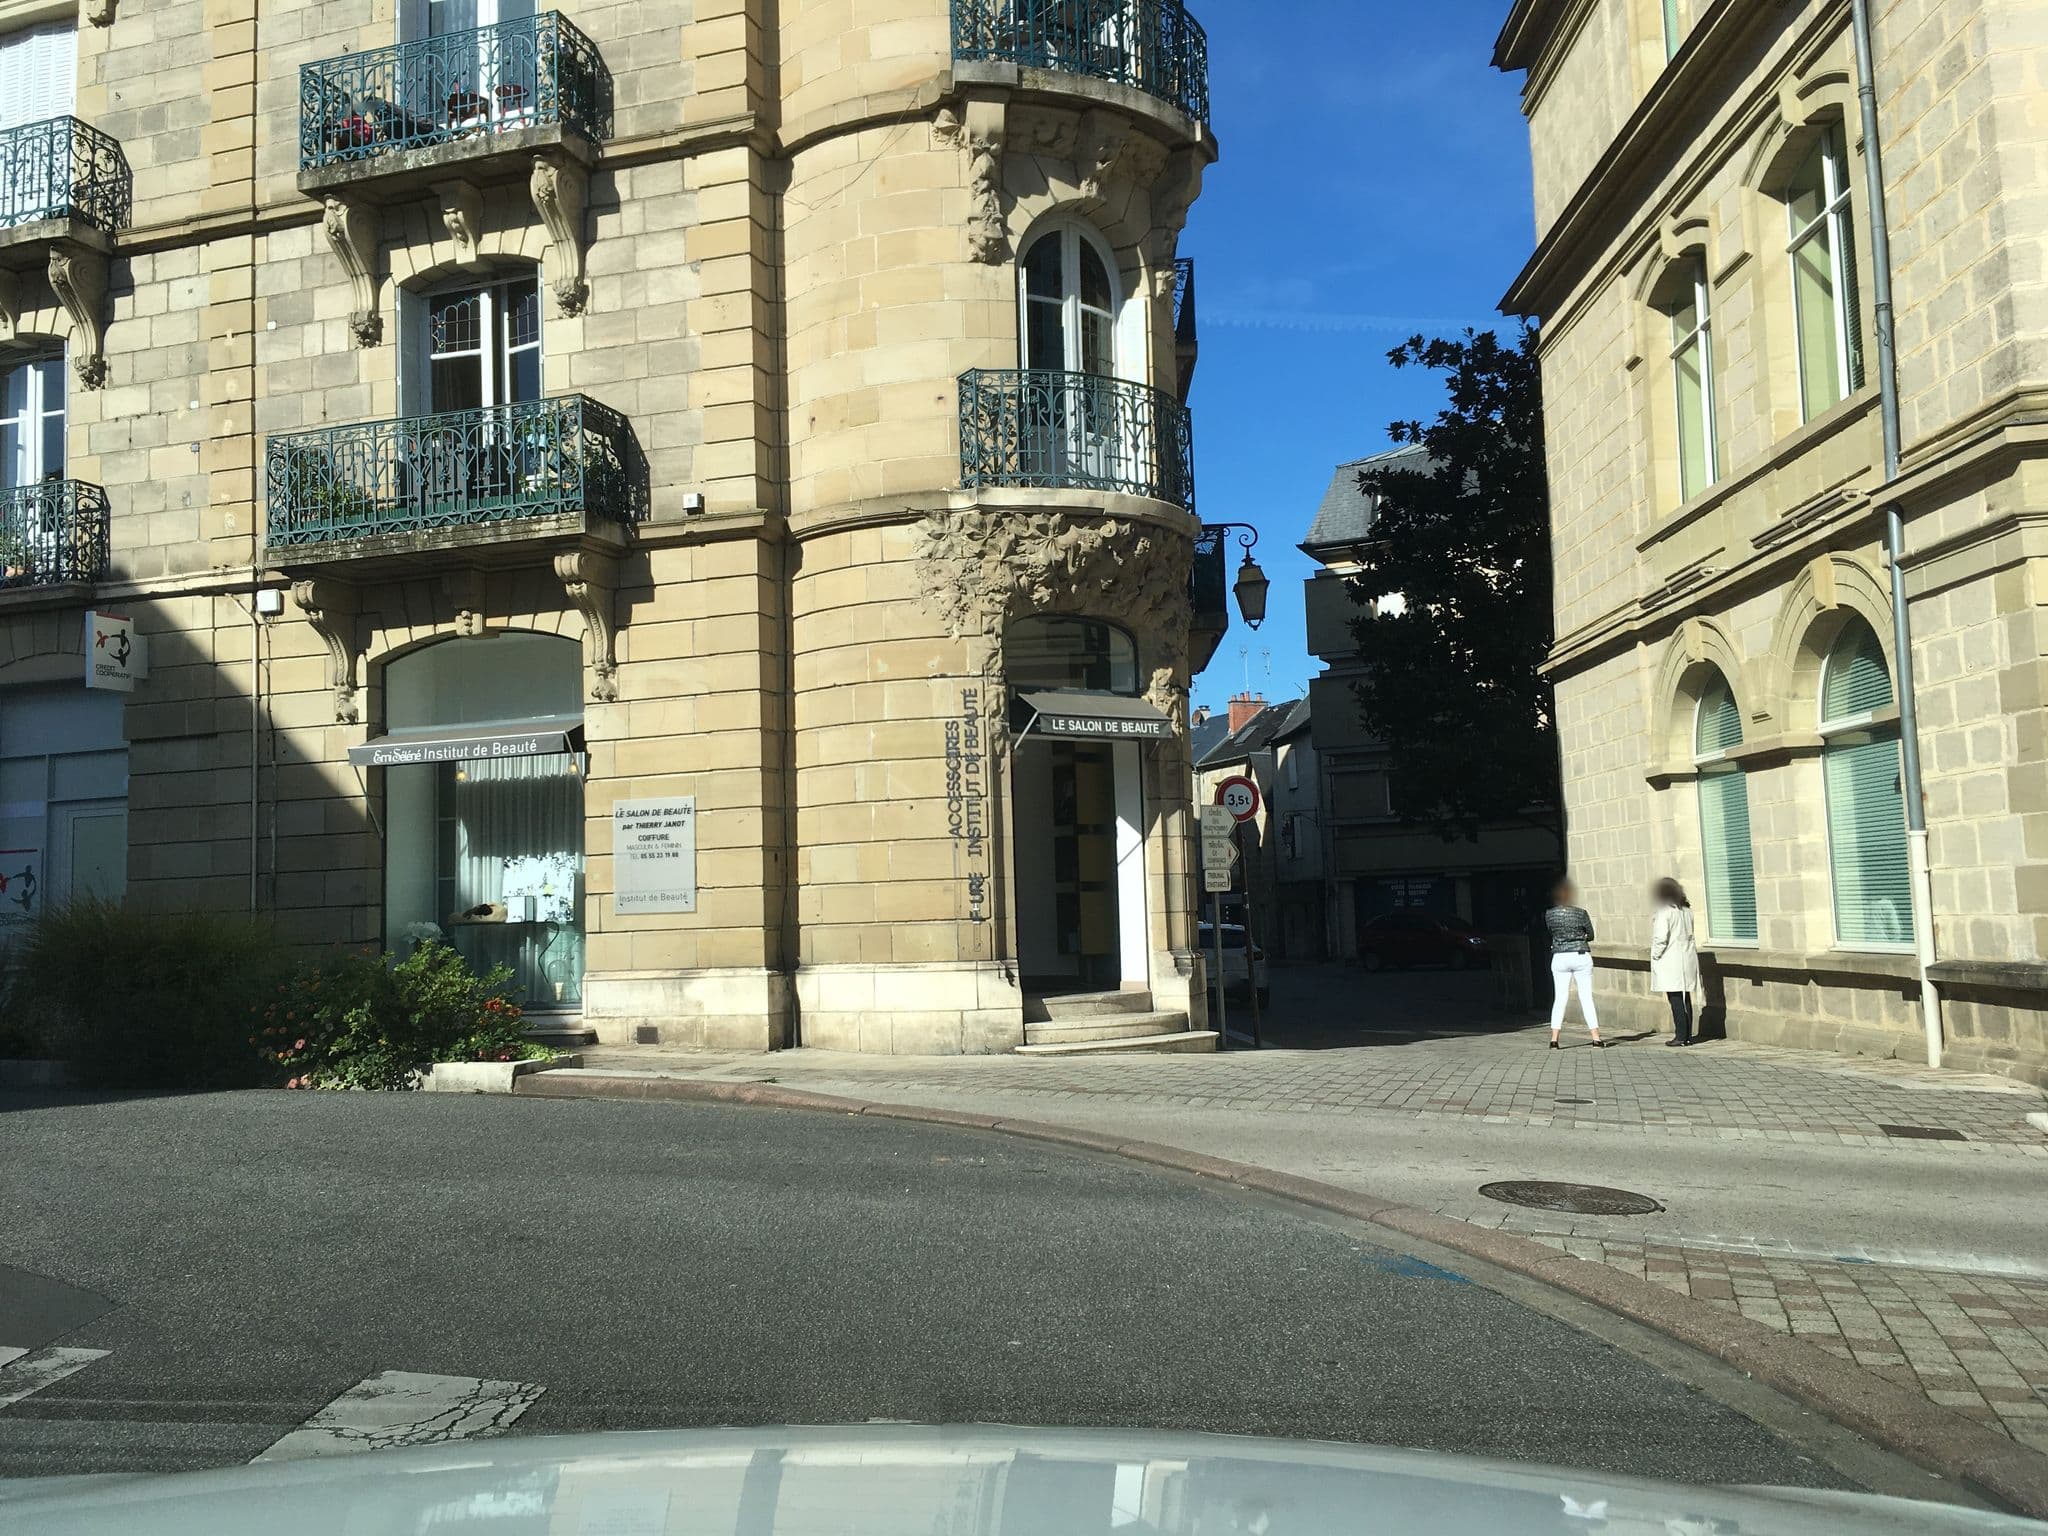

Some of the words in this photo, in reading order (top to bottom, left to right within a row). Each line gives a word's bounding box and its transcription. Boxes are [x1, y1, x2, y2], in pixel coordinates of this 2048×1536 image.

[960, 687, 979, 749] BEAUTÉ
[1052, 719, 1066, 731] LE
[1068, 720, 1102, 732] SALON
[1105, 721, 1119, 733] DE
[1121, 722, 1160, 734] BEAUTE
[424, 745, 469, 760] Institut
[472, 744, 488, 757] de
[492, 739, 537, 754] Beauté
[964, 752, 981, 774] DE
[945, 720, 962, 838] ACCESSOIRES
[1228, 794, 1250, 808] 3,5t
[615, 810, 625, 818] LE
[626, 809, 650, 818] SALON
[652, 808, 662, 816] DE
[966, 778, 983, 858] INSTITUT
[635, 821, 663, 829] THIERRY
[664, 820, 686, 828] JANOT
[638, 833, 670, 842] COIFFURE
[619, 894, 647, 903] Institut
[649, 893, 658, 902] de
